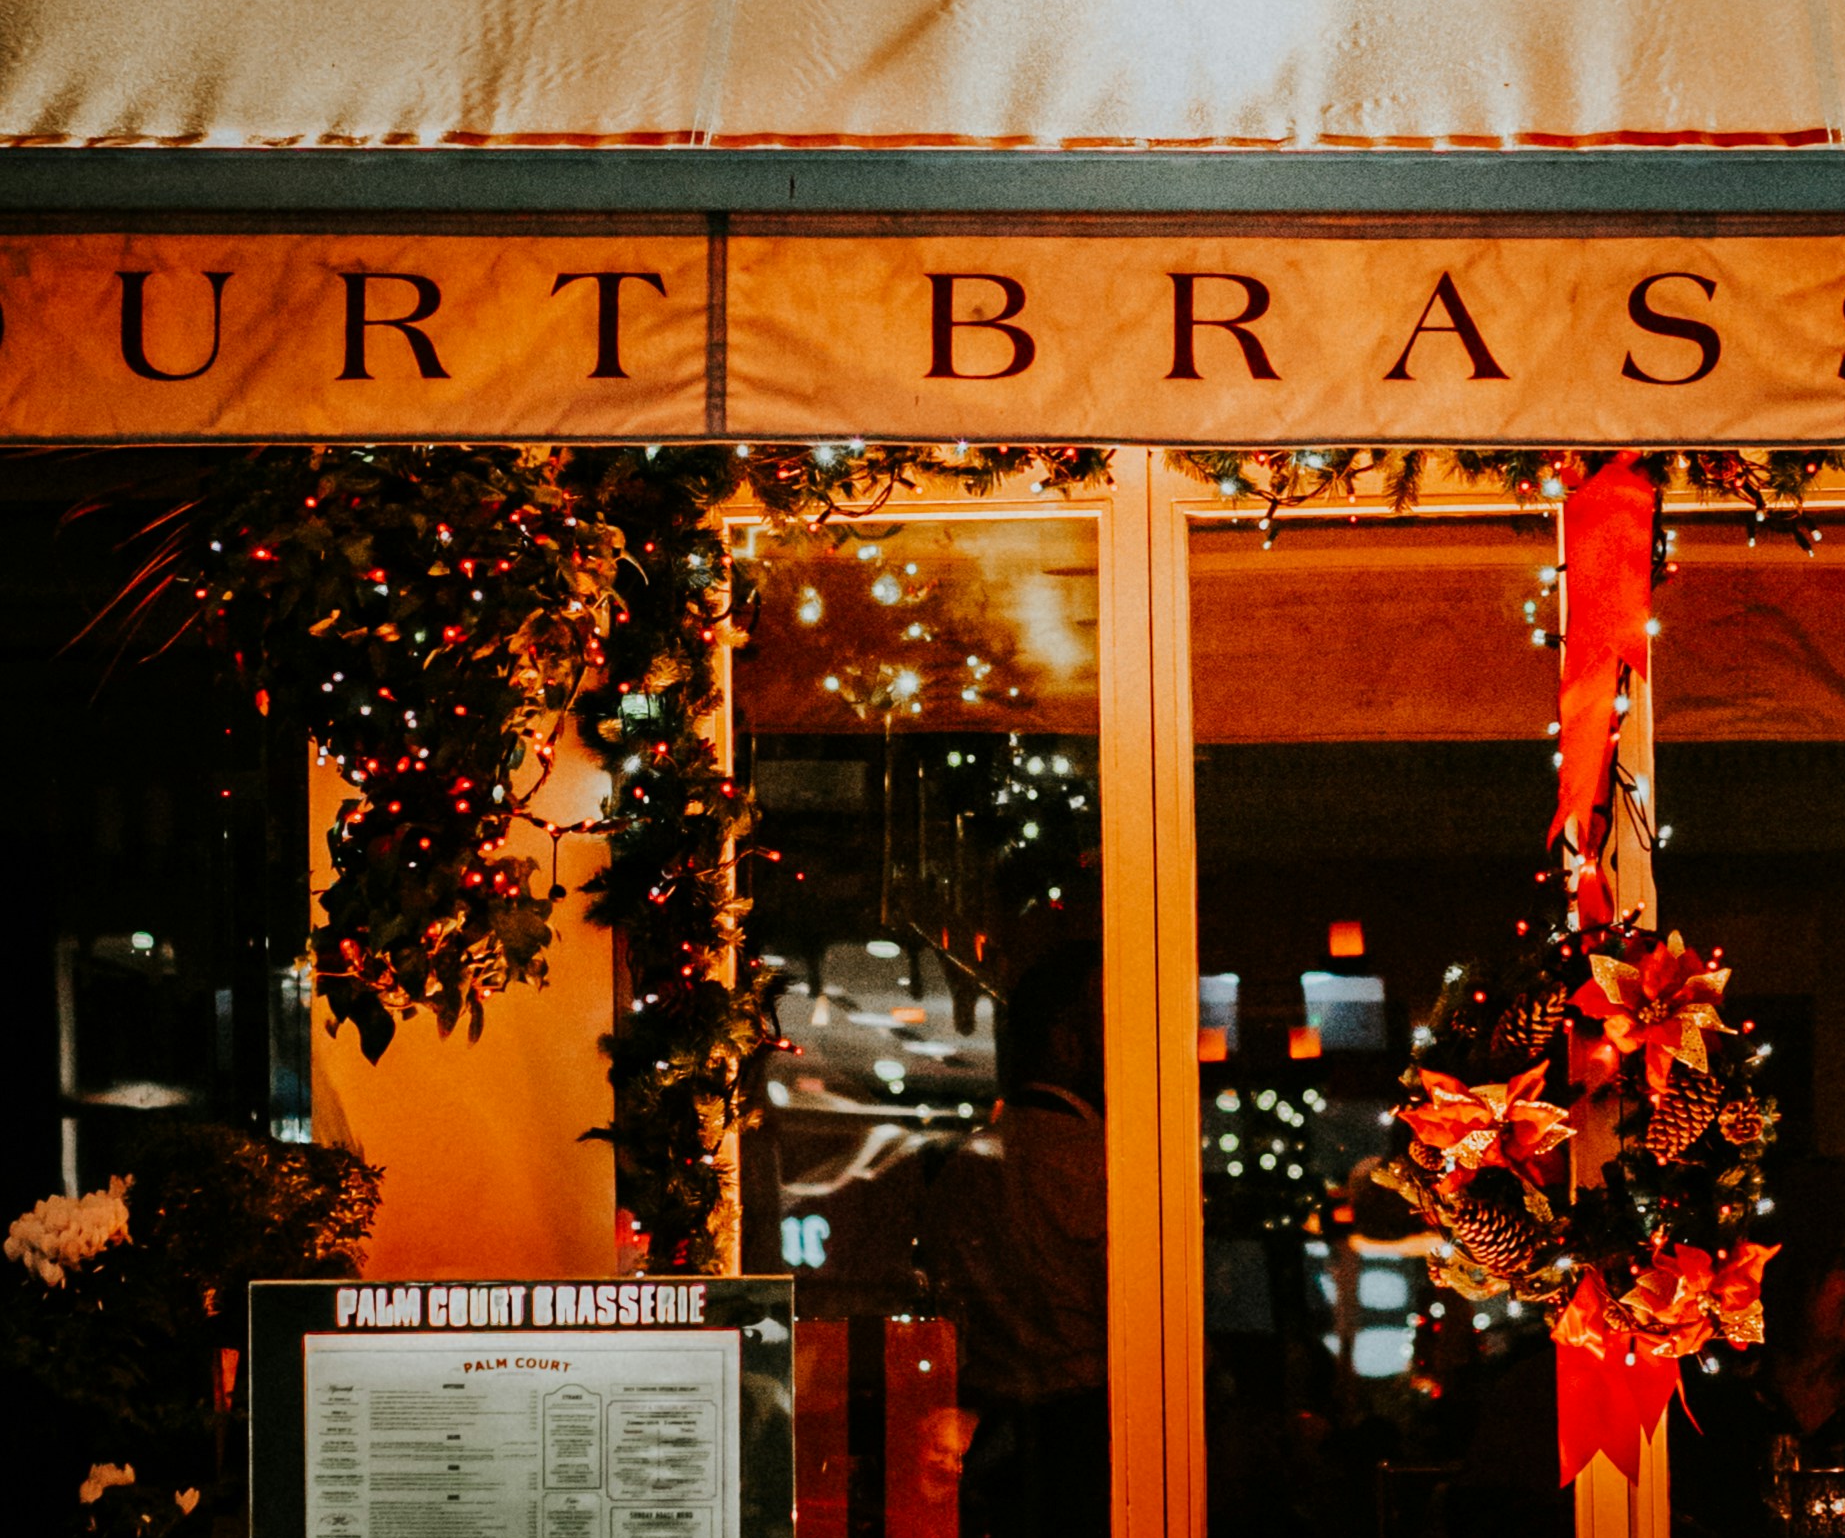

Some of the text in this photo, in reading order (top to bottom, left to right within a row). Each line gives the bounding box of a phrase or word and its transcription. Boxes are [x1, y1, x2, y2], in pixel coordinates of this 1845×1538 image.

[0, 269, 668, 383] URT
[336, 1284, 705, 1327] PALM COURT BRASSERIE
[463, 1357, 508, 1374] PALM
[515, 1356, 573, 1373] COURT
